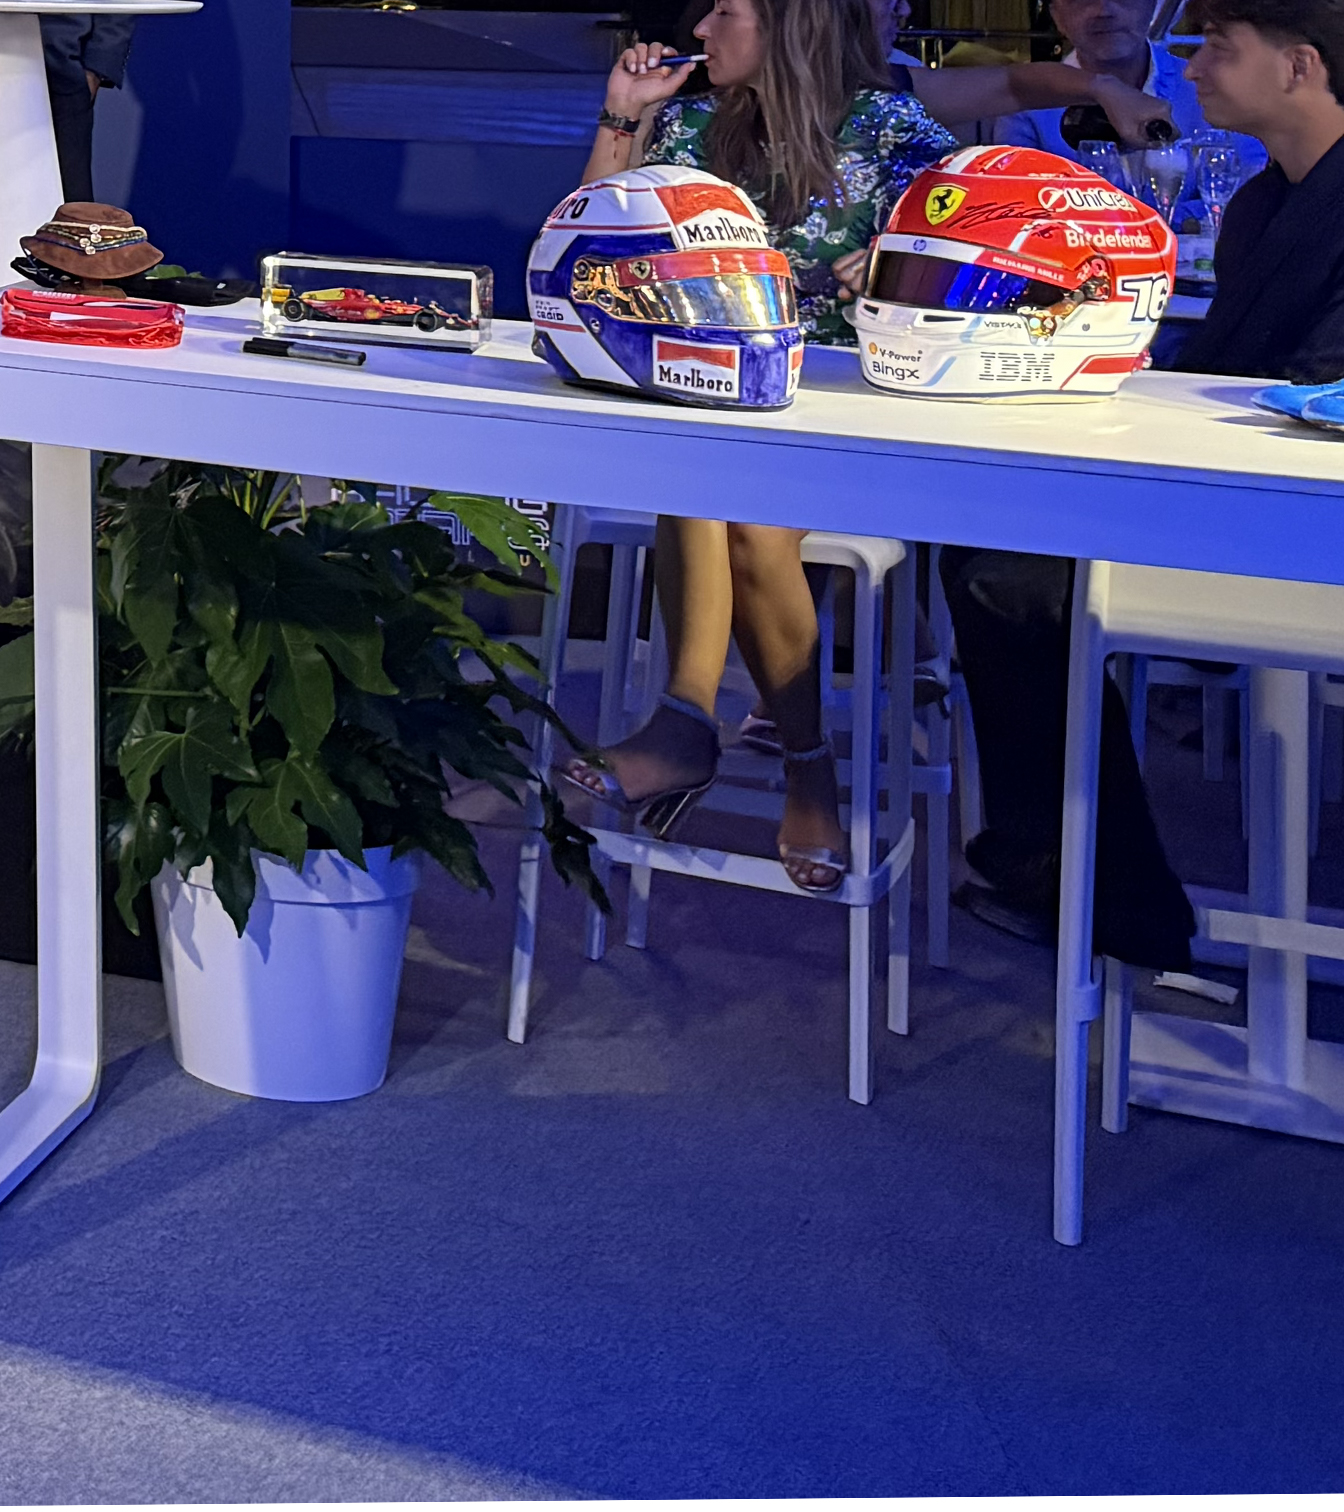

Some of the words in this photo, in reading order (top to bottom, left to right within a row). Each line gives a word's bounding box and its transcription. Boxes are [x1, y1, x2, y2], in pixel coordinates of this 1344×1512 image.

[685, 217, 762, 245] Marlboro
[658, 364, 734, 393] Marlboro
[979, 351, 1055, 382] IBM
